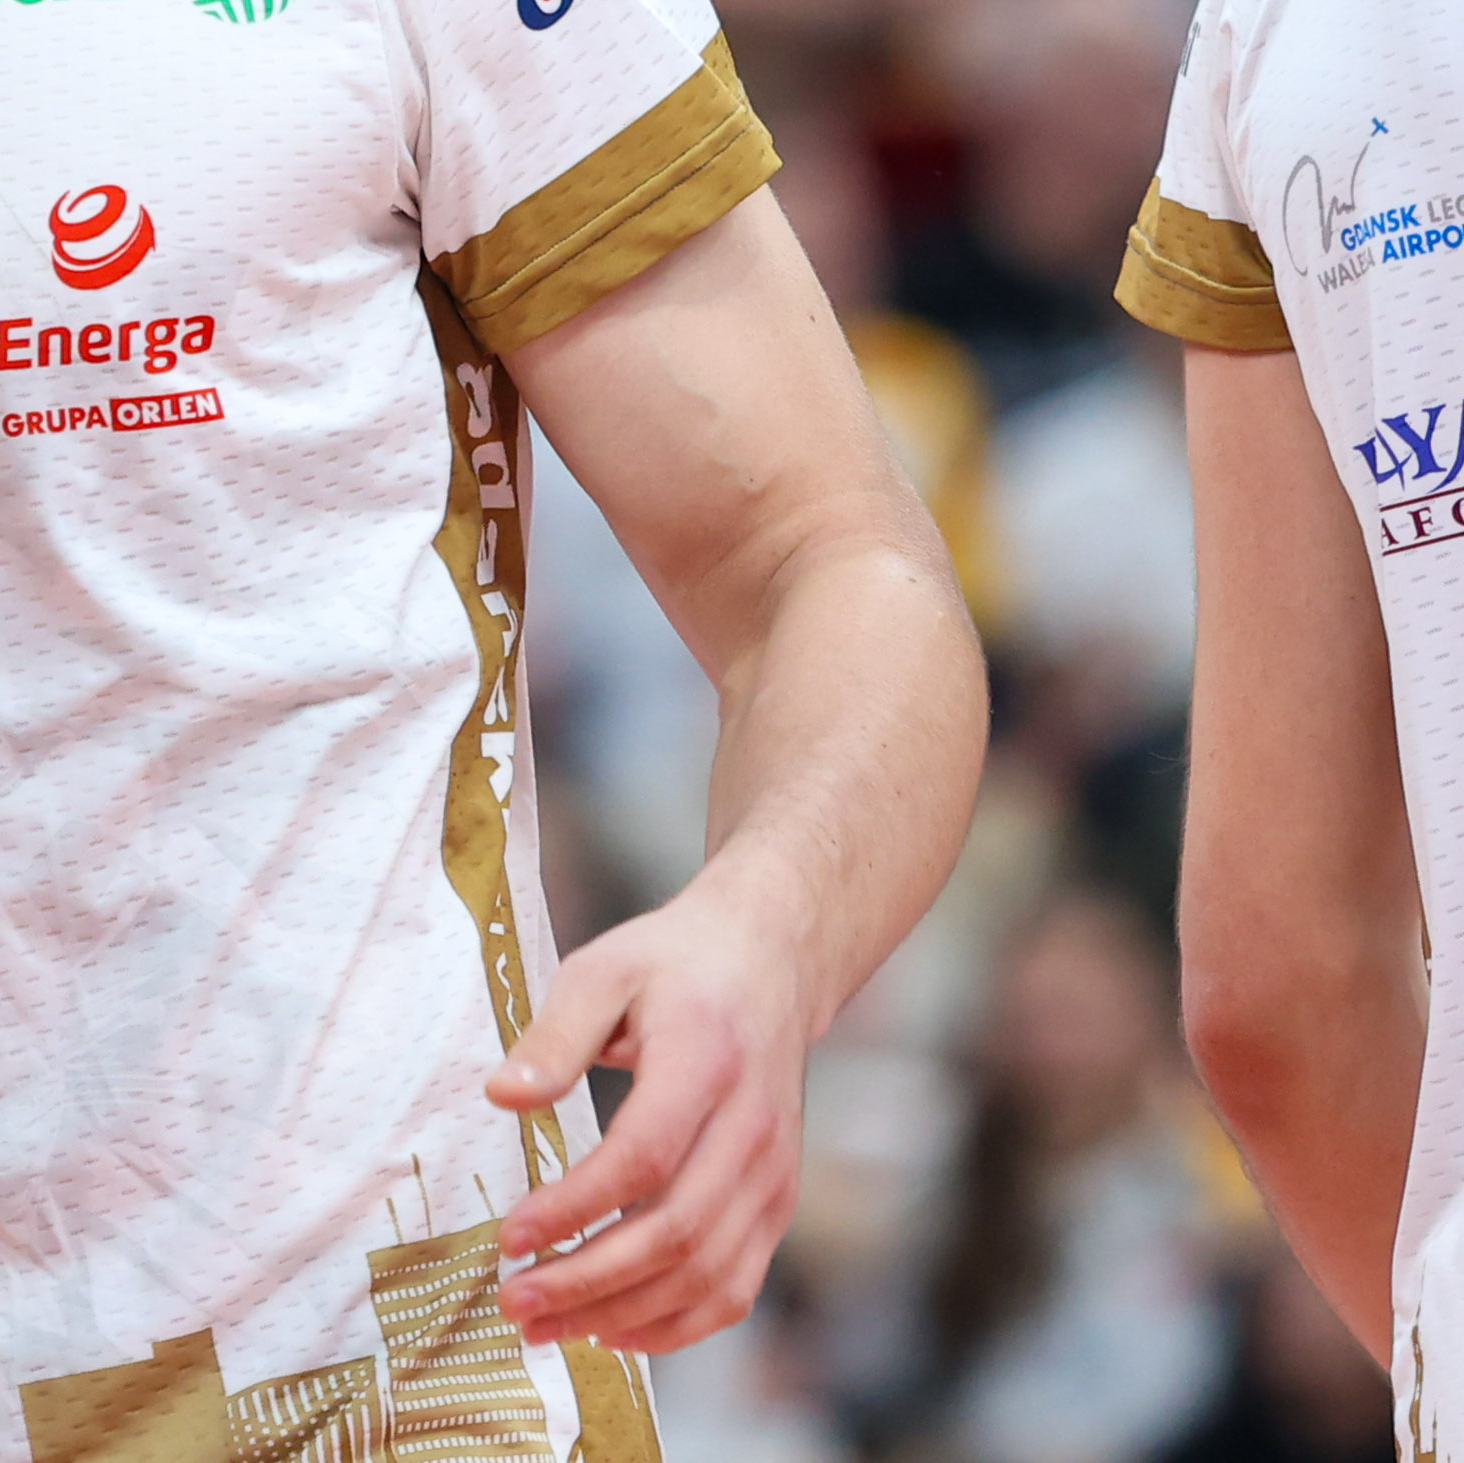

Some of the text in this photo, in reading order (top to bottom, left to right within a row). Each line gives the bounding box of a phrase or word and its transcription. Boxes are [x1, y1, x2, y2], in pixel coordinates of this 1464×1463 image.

[1382, 222, 1464, 264] AIRPO
[2, 392, 219, 437] GRUPA ORLEN
